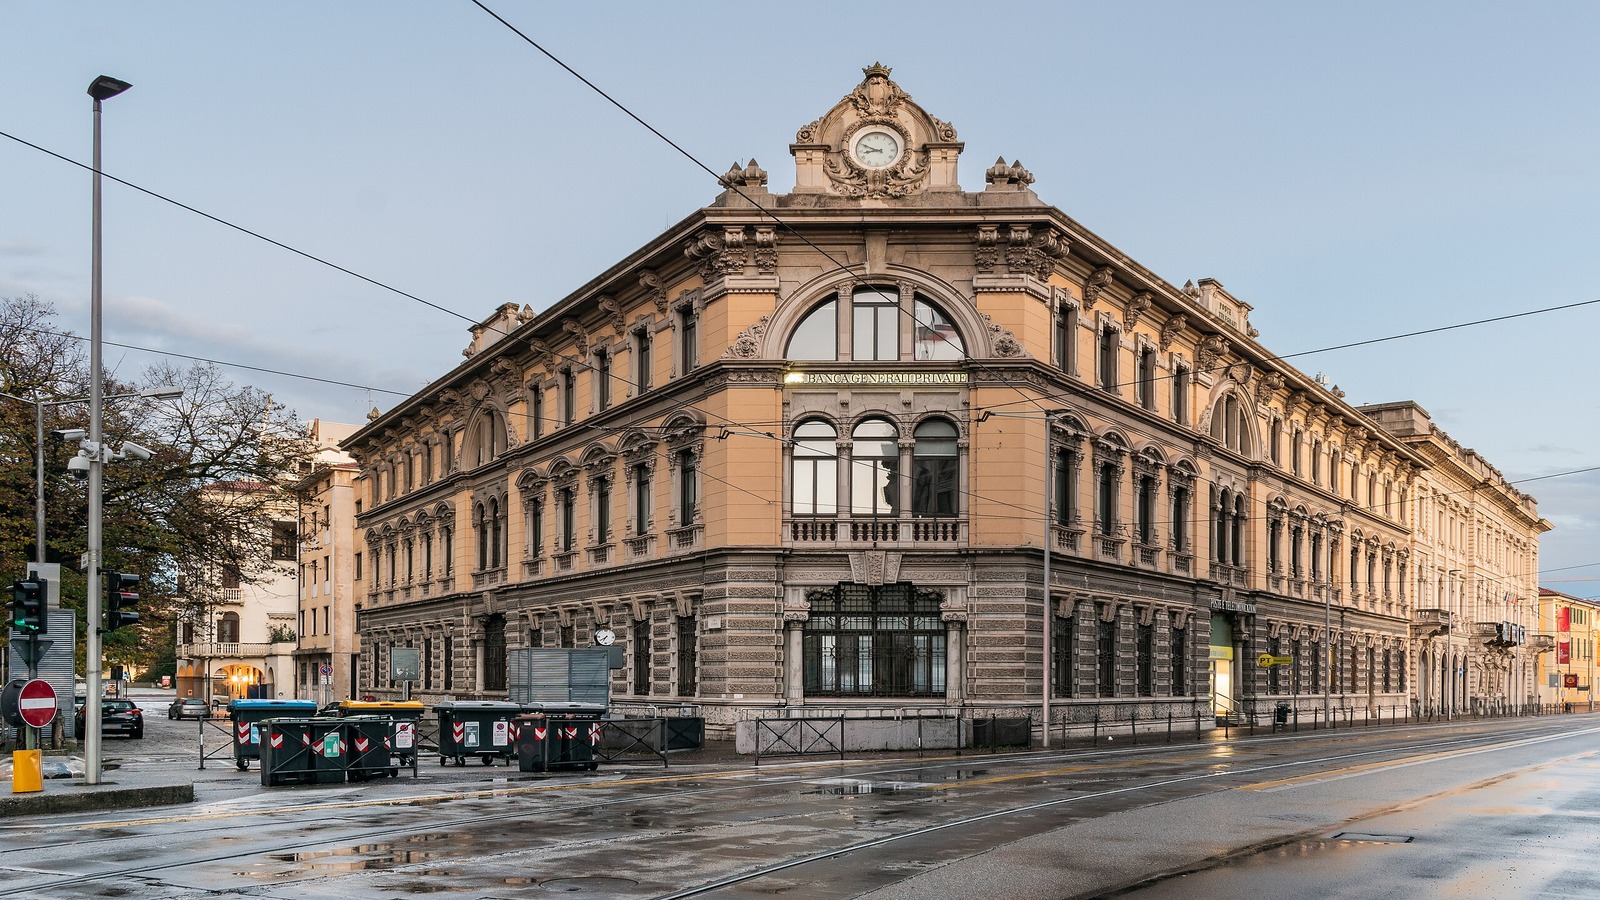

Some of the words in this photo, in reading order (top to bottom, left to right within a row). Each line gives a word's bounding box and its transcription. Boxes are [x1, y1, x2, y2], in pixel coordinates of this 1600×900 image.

[808, 373, 849, 384] BANCA
[850, 373, 910, 384] GENERALI
[914, 373, 967, 384] PRIVATE
